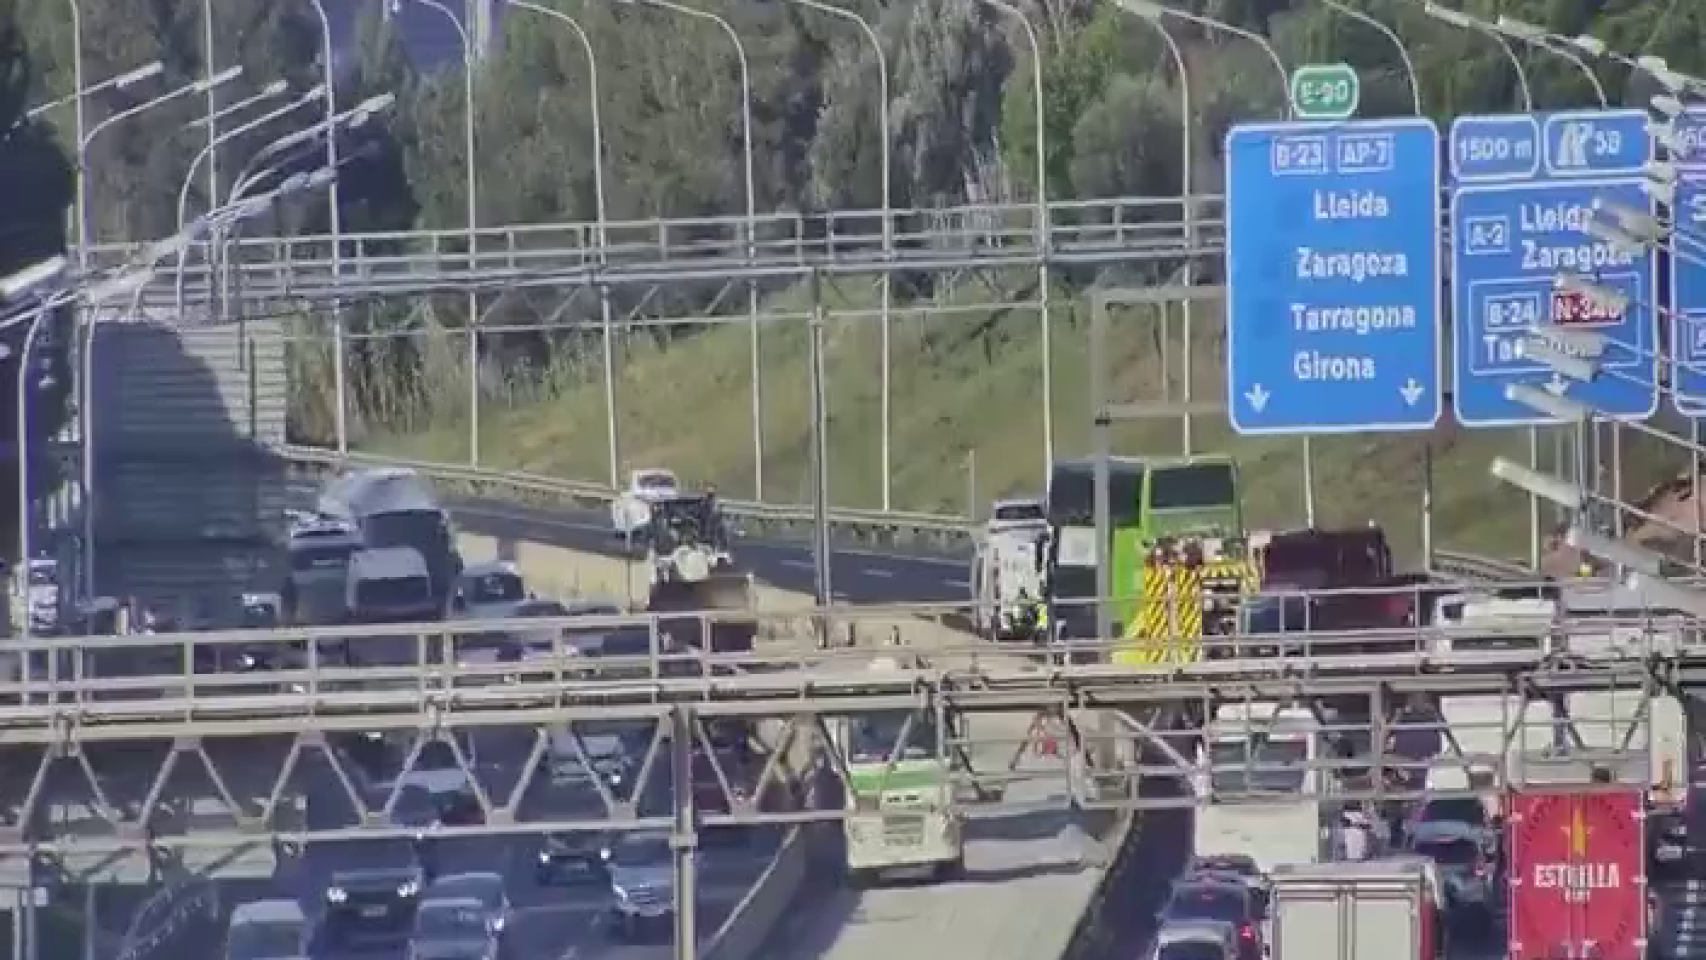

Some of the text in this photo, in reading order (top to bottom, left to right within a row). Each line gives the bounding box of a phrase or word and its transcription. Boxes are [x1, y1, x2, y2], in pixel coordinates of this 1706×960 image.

[1300, 79, 1349, 106] E-90
[1276, 140, 1387, 168] B-23 AP-7
[1459, 137, 1533, 161] 1500 m
[1314, 189, 1388, 219] Lleida
[1470, 222, 1504, 247] A-2
[1297, 246, 1408, 284] Zaragoza
[1289, 302, 1416, 335] Tarragona
[1294, 350, 1375, 381] Girona
[1533, 863, 1620, 888] ESTRELLA
